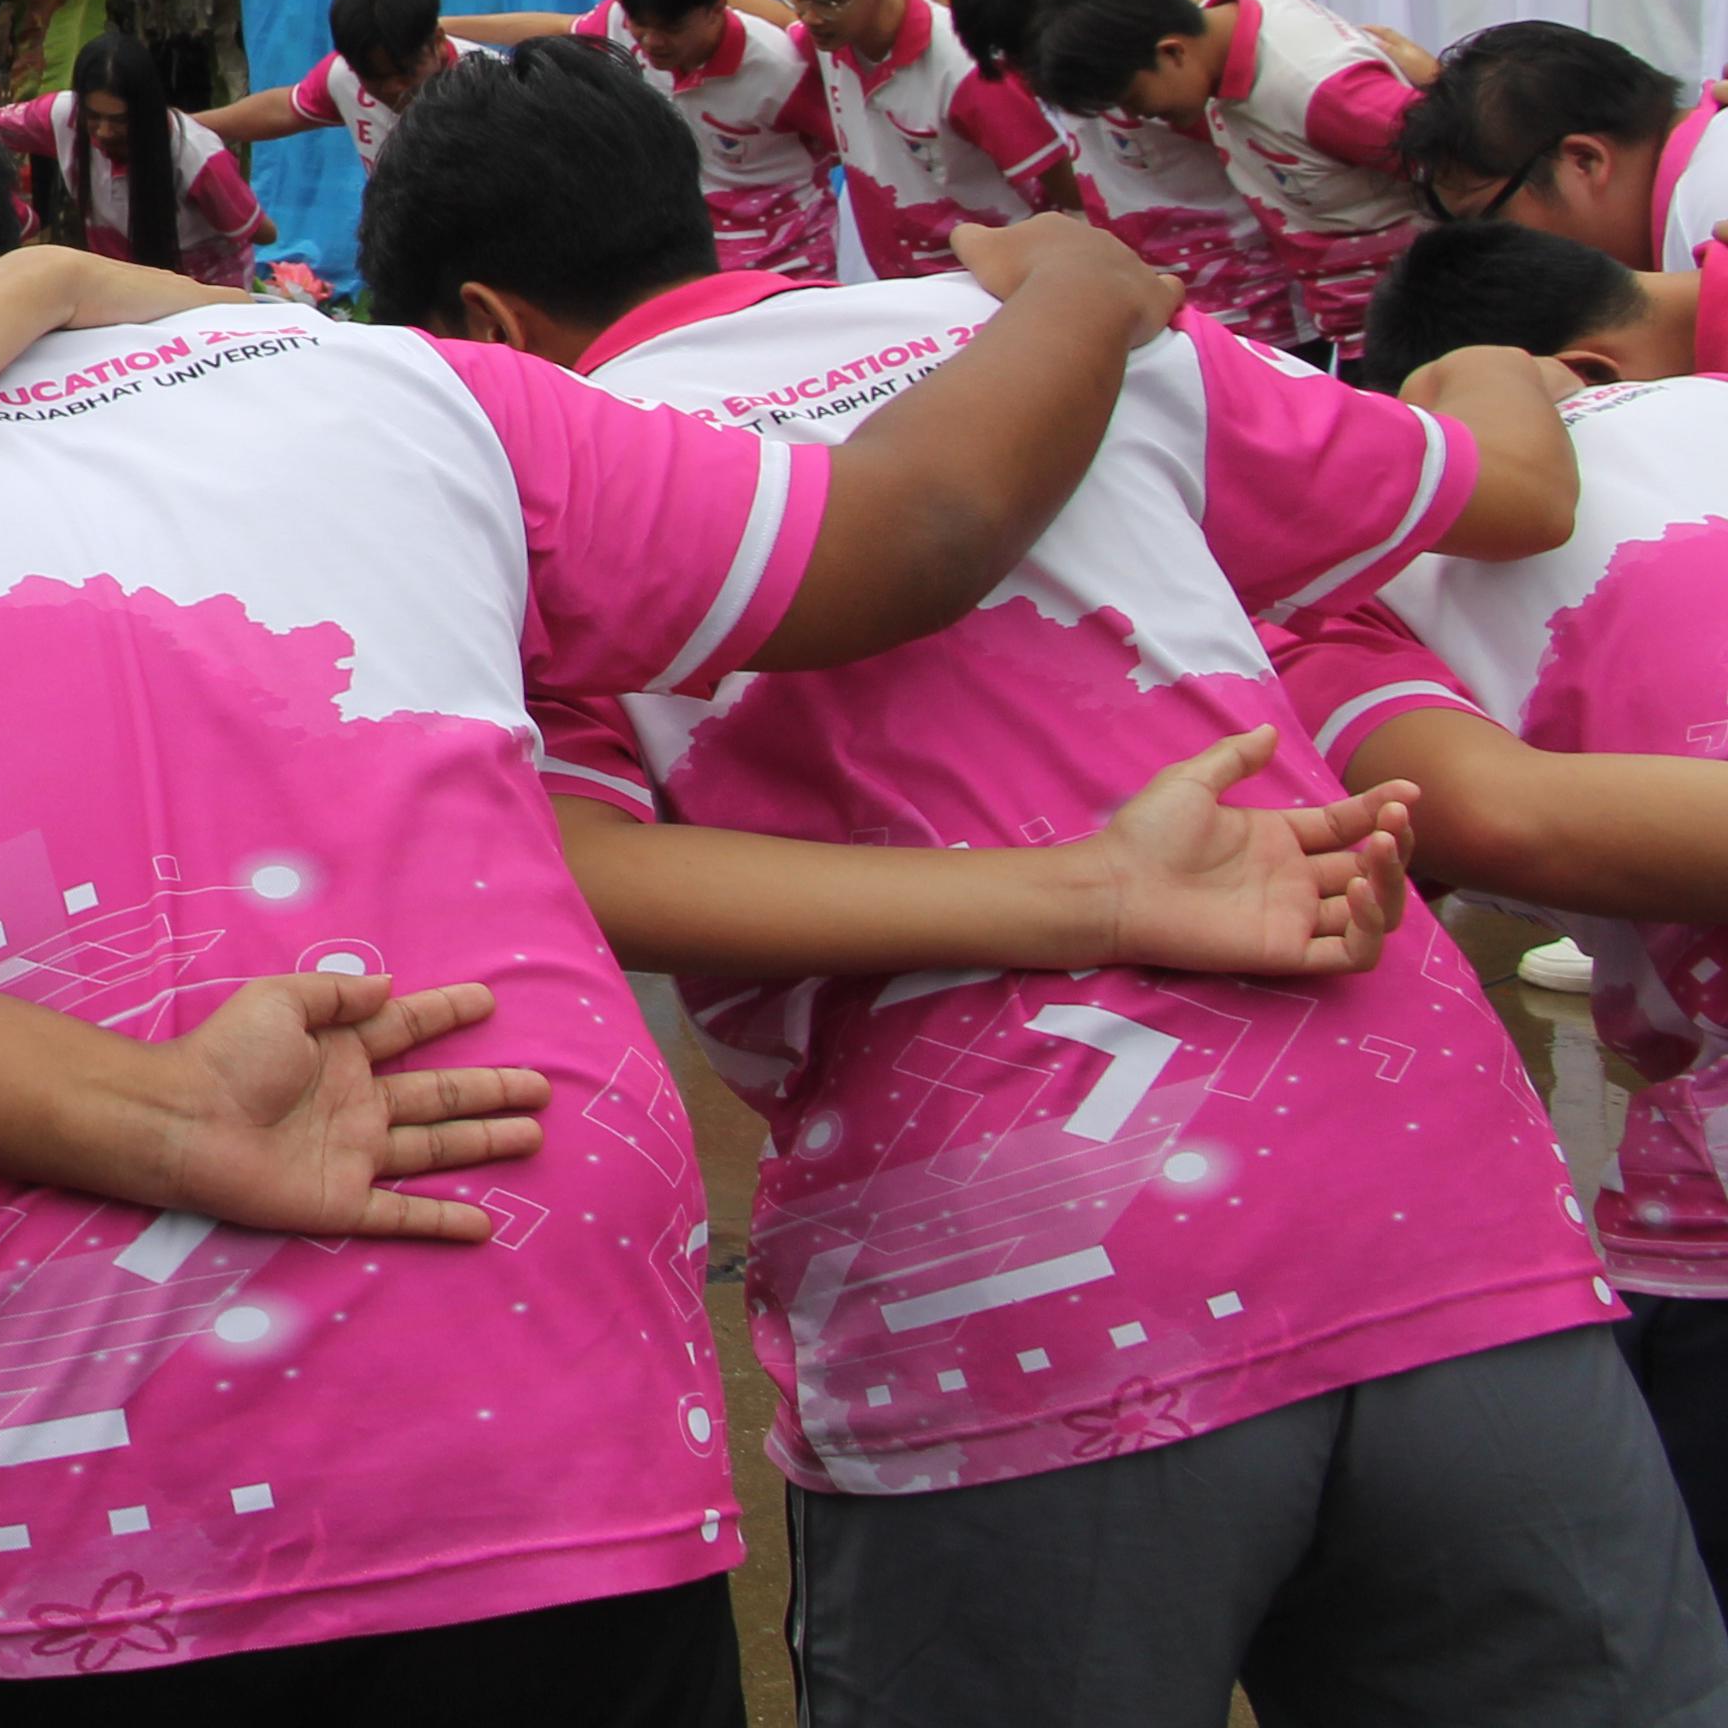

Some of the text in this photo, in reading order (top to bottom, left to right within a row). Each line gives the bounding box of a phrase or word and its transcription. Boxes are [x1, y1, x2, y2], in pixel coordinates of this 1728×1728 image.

[153, 336, 321, 388] UNIVERSITY
[721, 335, 942, 419] EDUCATION
[769, 378, 897, 426] RJABHAT
